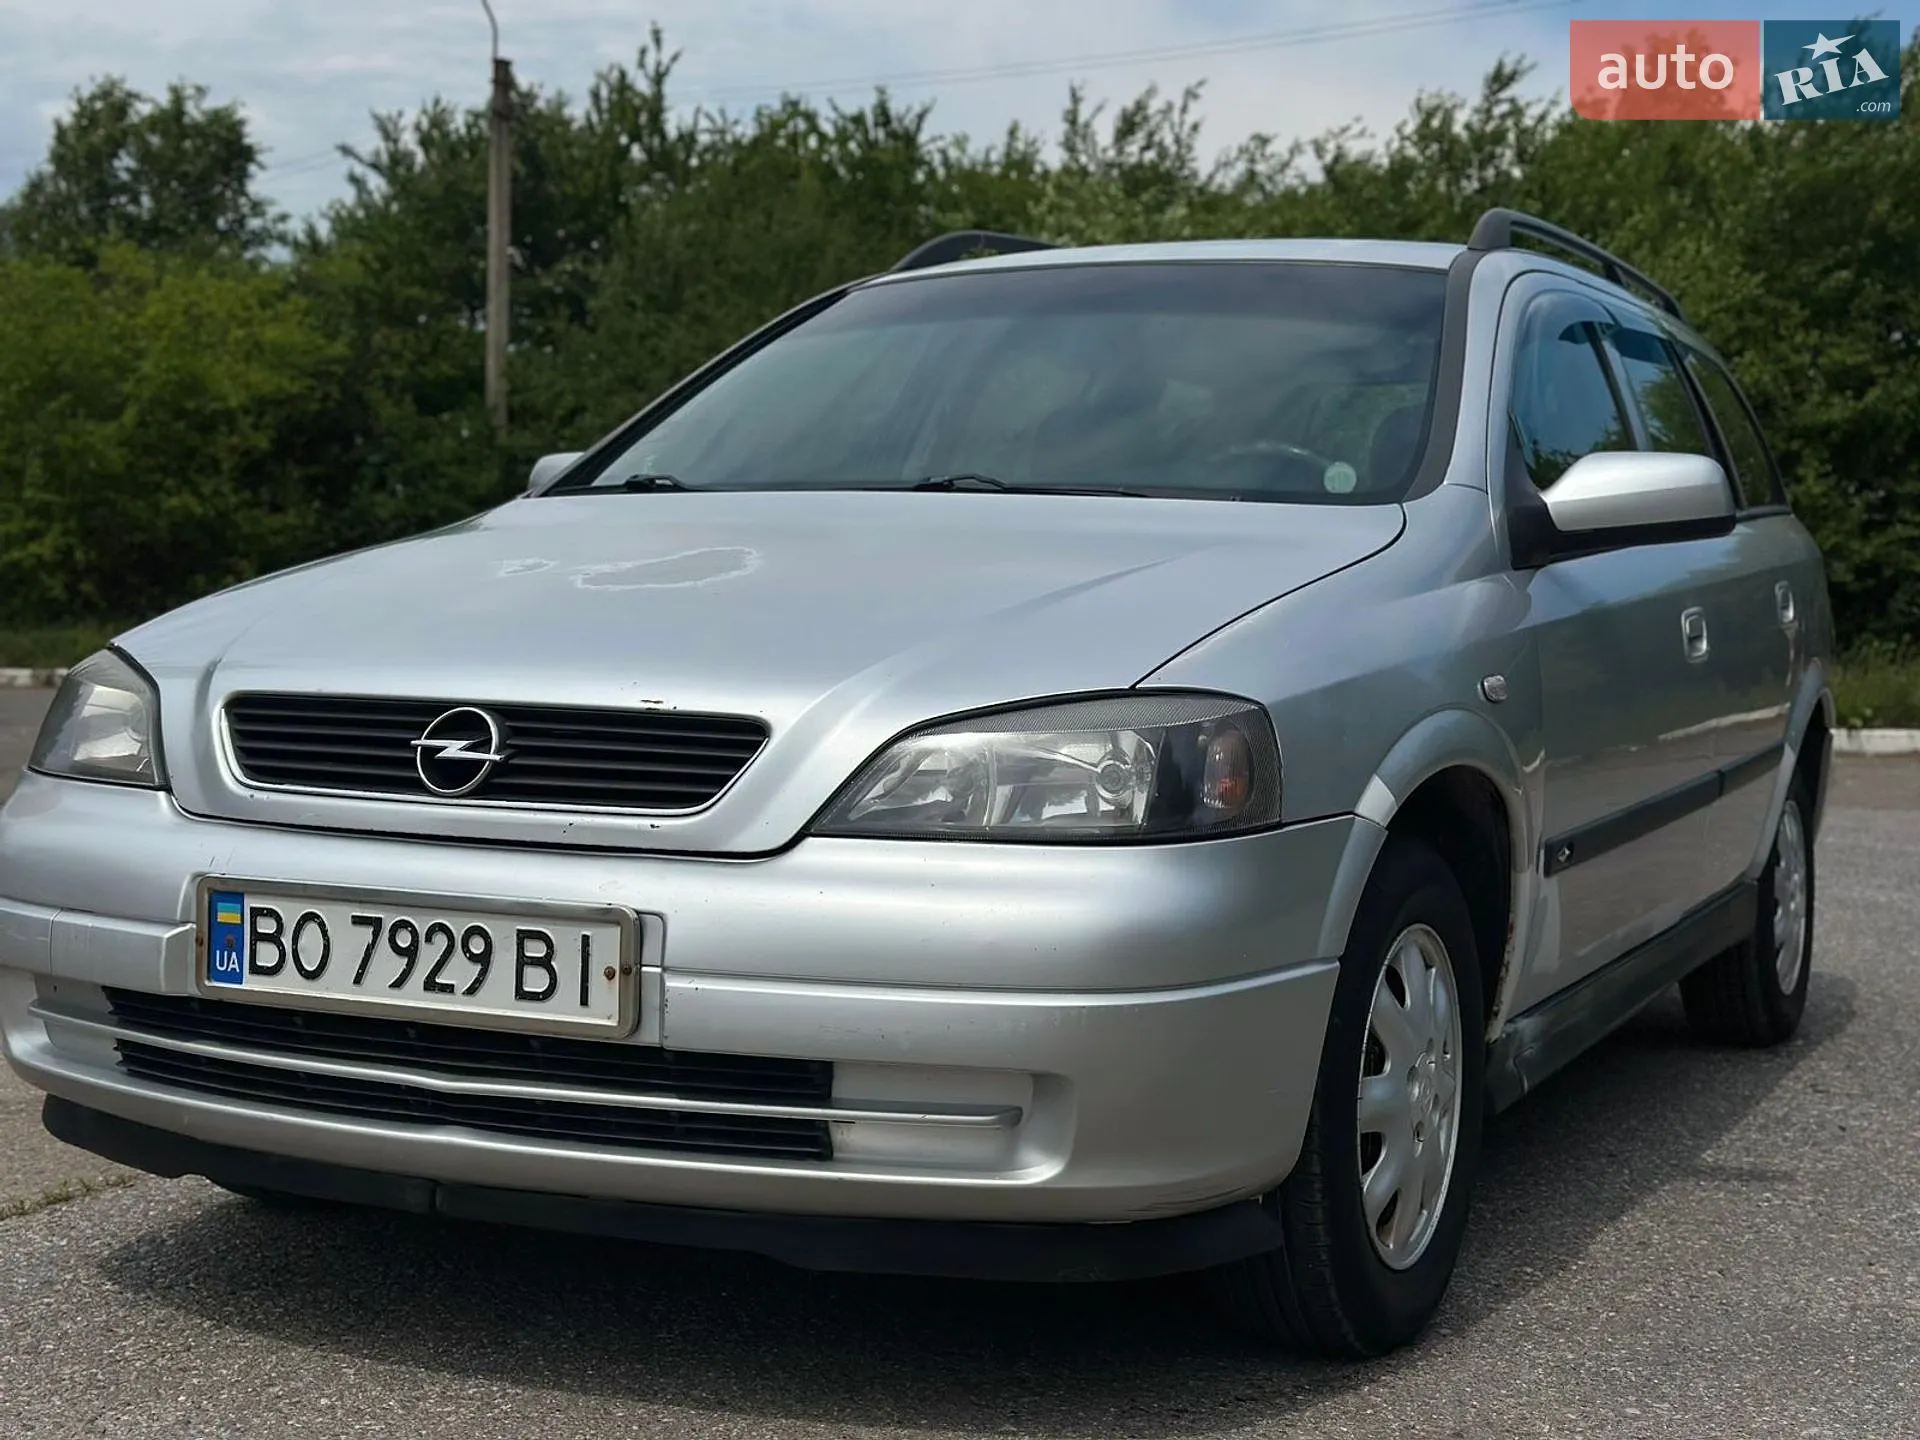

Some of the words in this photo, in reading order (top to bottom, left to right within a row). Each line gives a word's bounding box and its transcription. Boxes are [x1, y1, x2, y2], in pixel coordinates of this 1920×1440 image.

[215, 949, 240, 974] UA
[248, 905, 332, 982] BO
[350, 914, 494, 997] 7929
[514, 926, 591, 1007] BI
